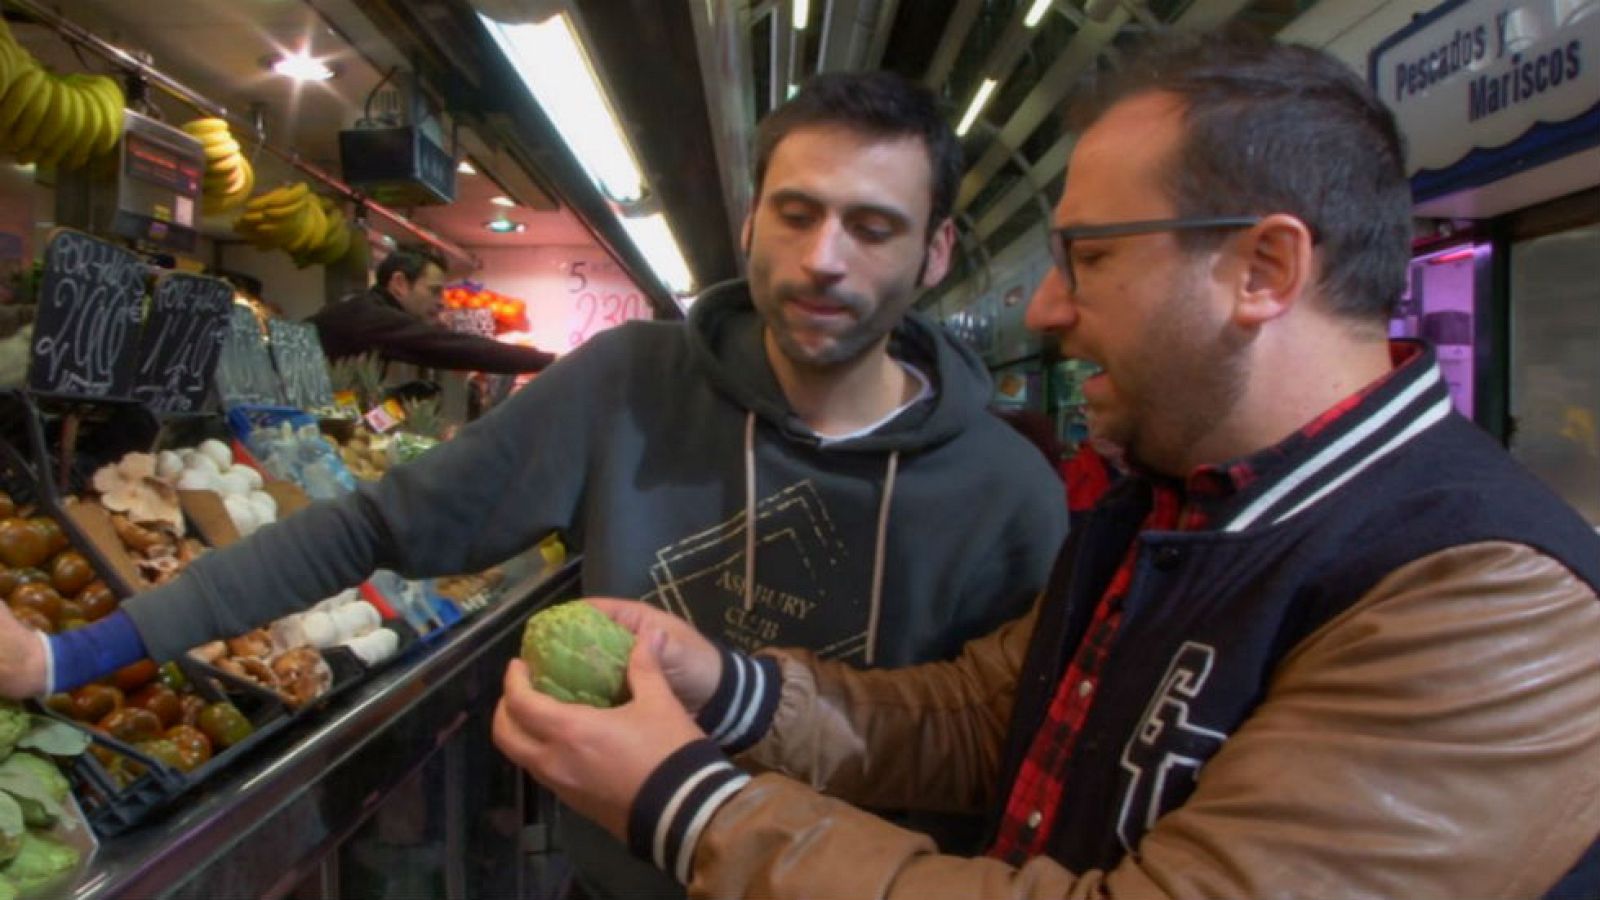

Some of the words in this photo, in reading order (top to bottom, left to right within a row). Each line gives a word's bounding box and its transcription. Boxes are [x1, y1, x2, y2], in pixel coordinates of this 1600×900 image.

[1396, 25, 1487, 101] Pescados
[1468, 40, 1581, 123] Mariscos
[724, 607, 780, 640] CLUB
